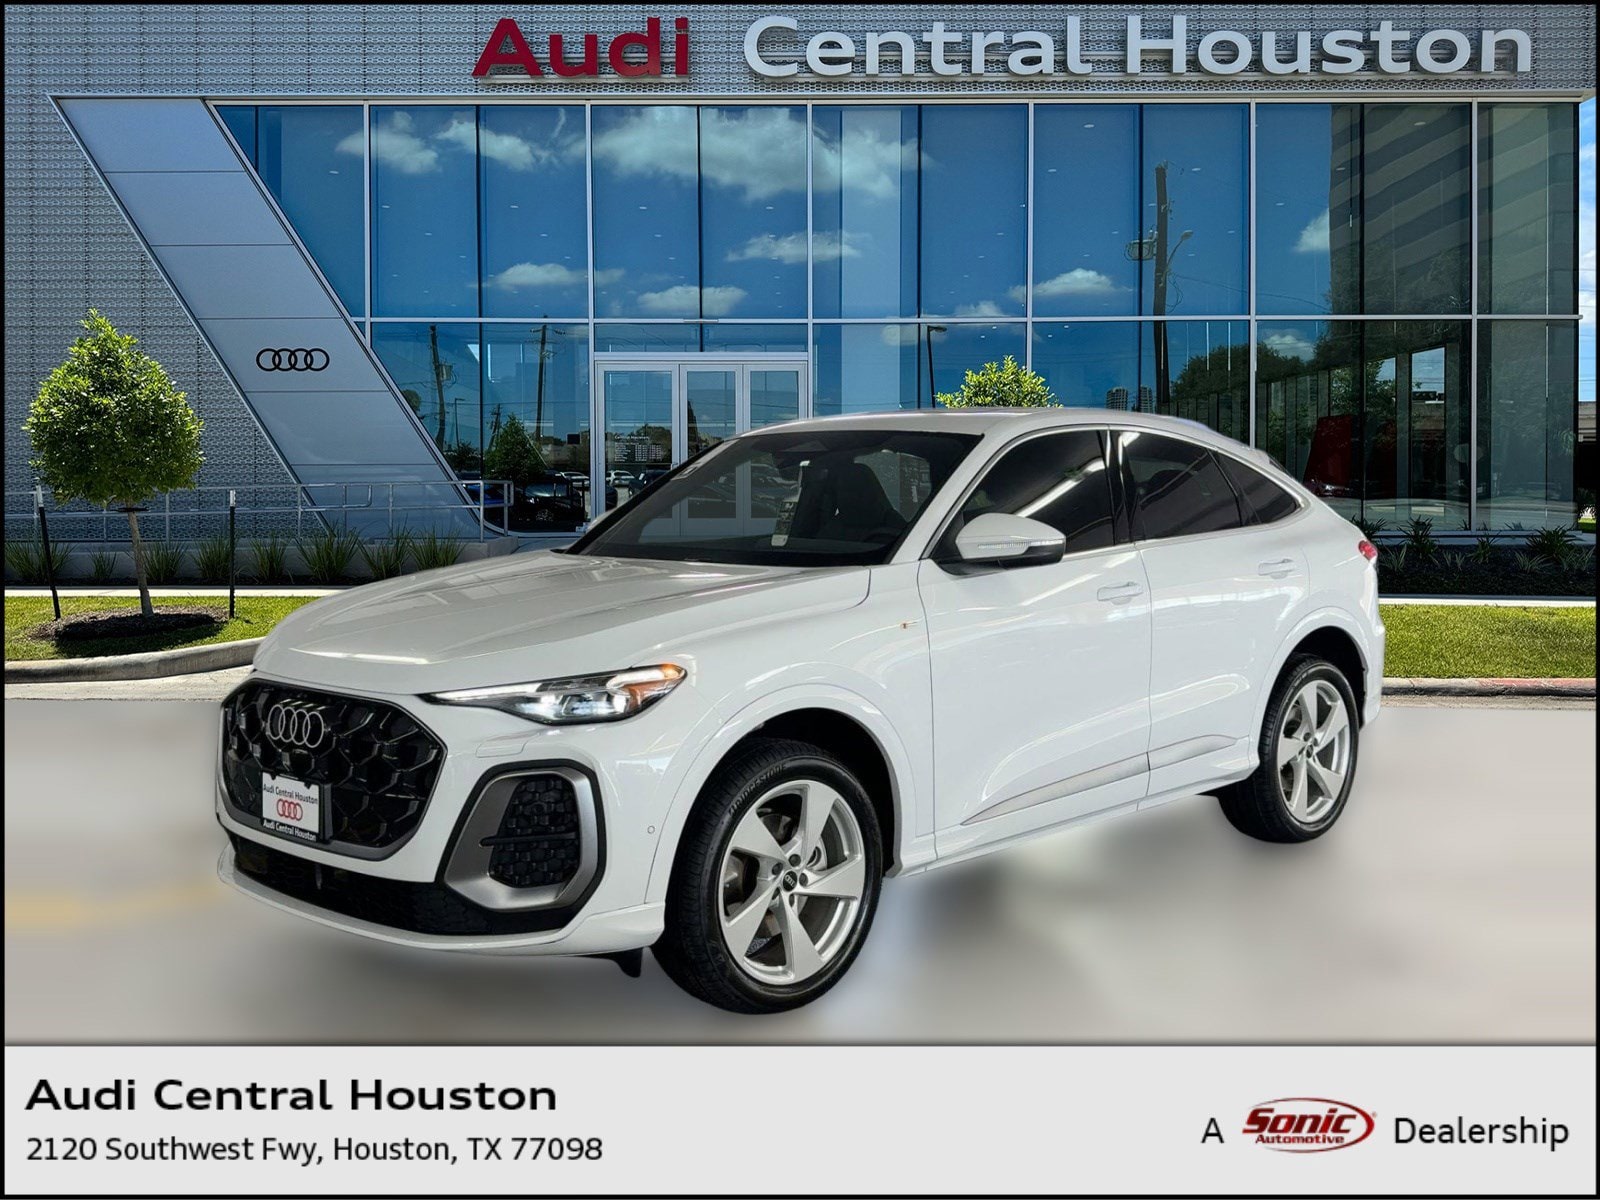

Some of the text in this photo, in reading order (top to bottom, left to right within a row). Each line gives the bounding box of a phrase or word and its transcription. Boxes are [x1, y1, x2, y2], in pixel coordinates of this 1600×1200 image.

[474, 15, 1533, 78] Audi Central Houston
[263, 784, 318, 804] Audi Central Houston
[263, 819, 316, 841] Audi Central Houston
